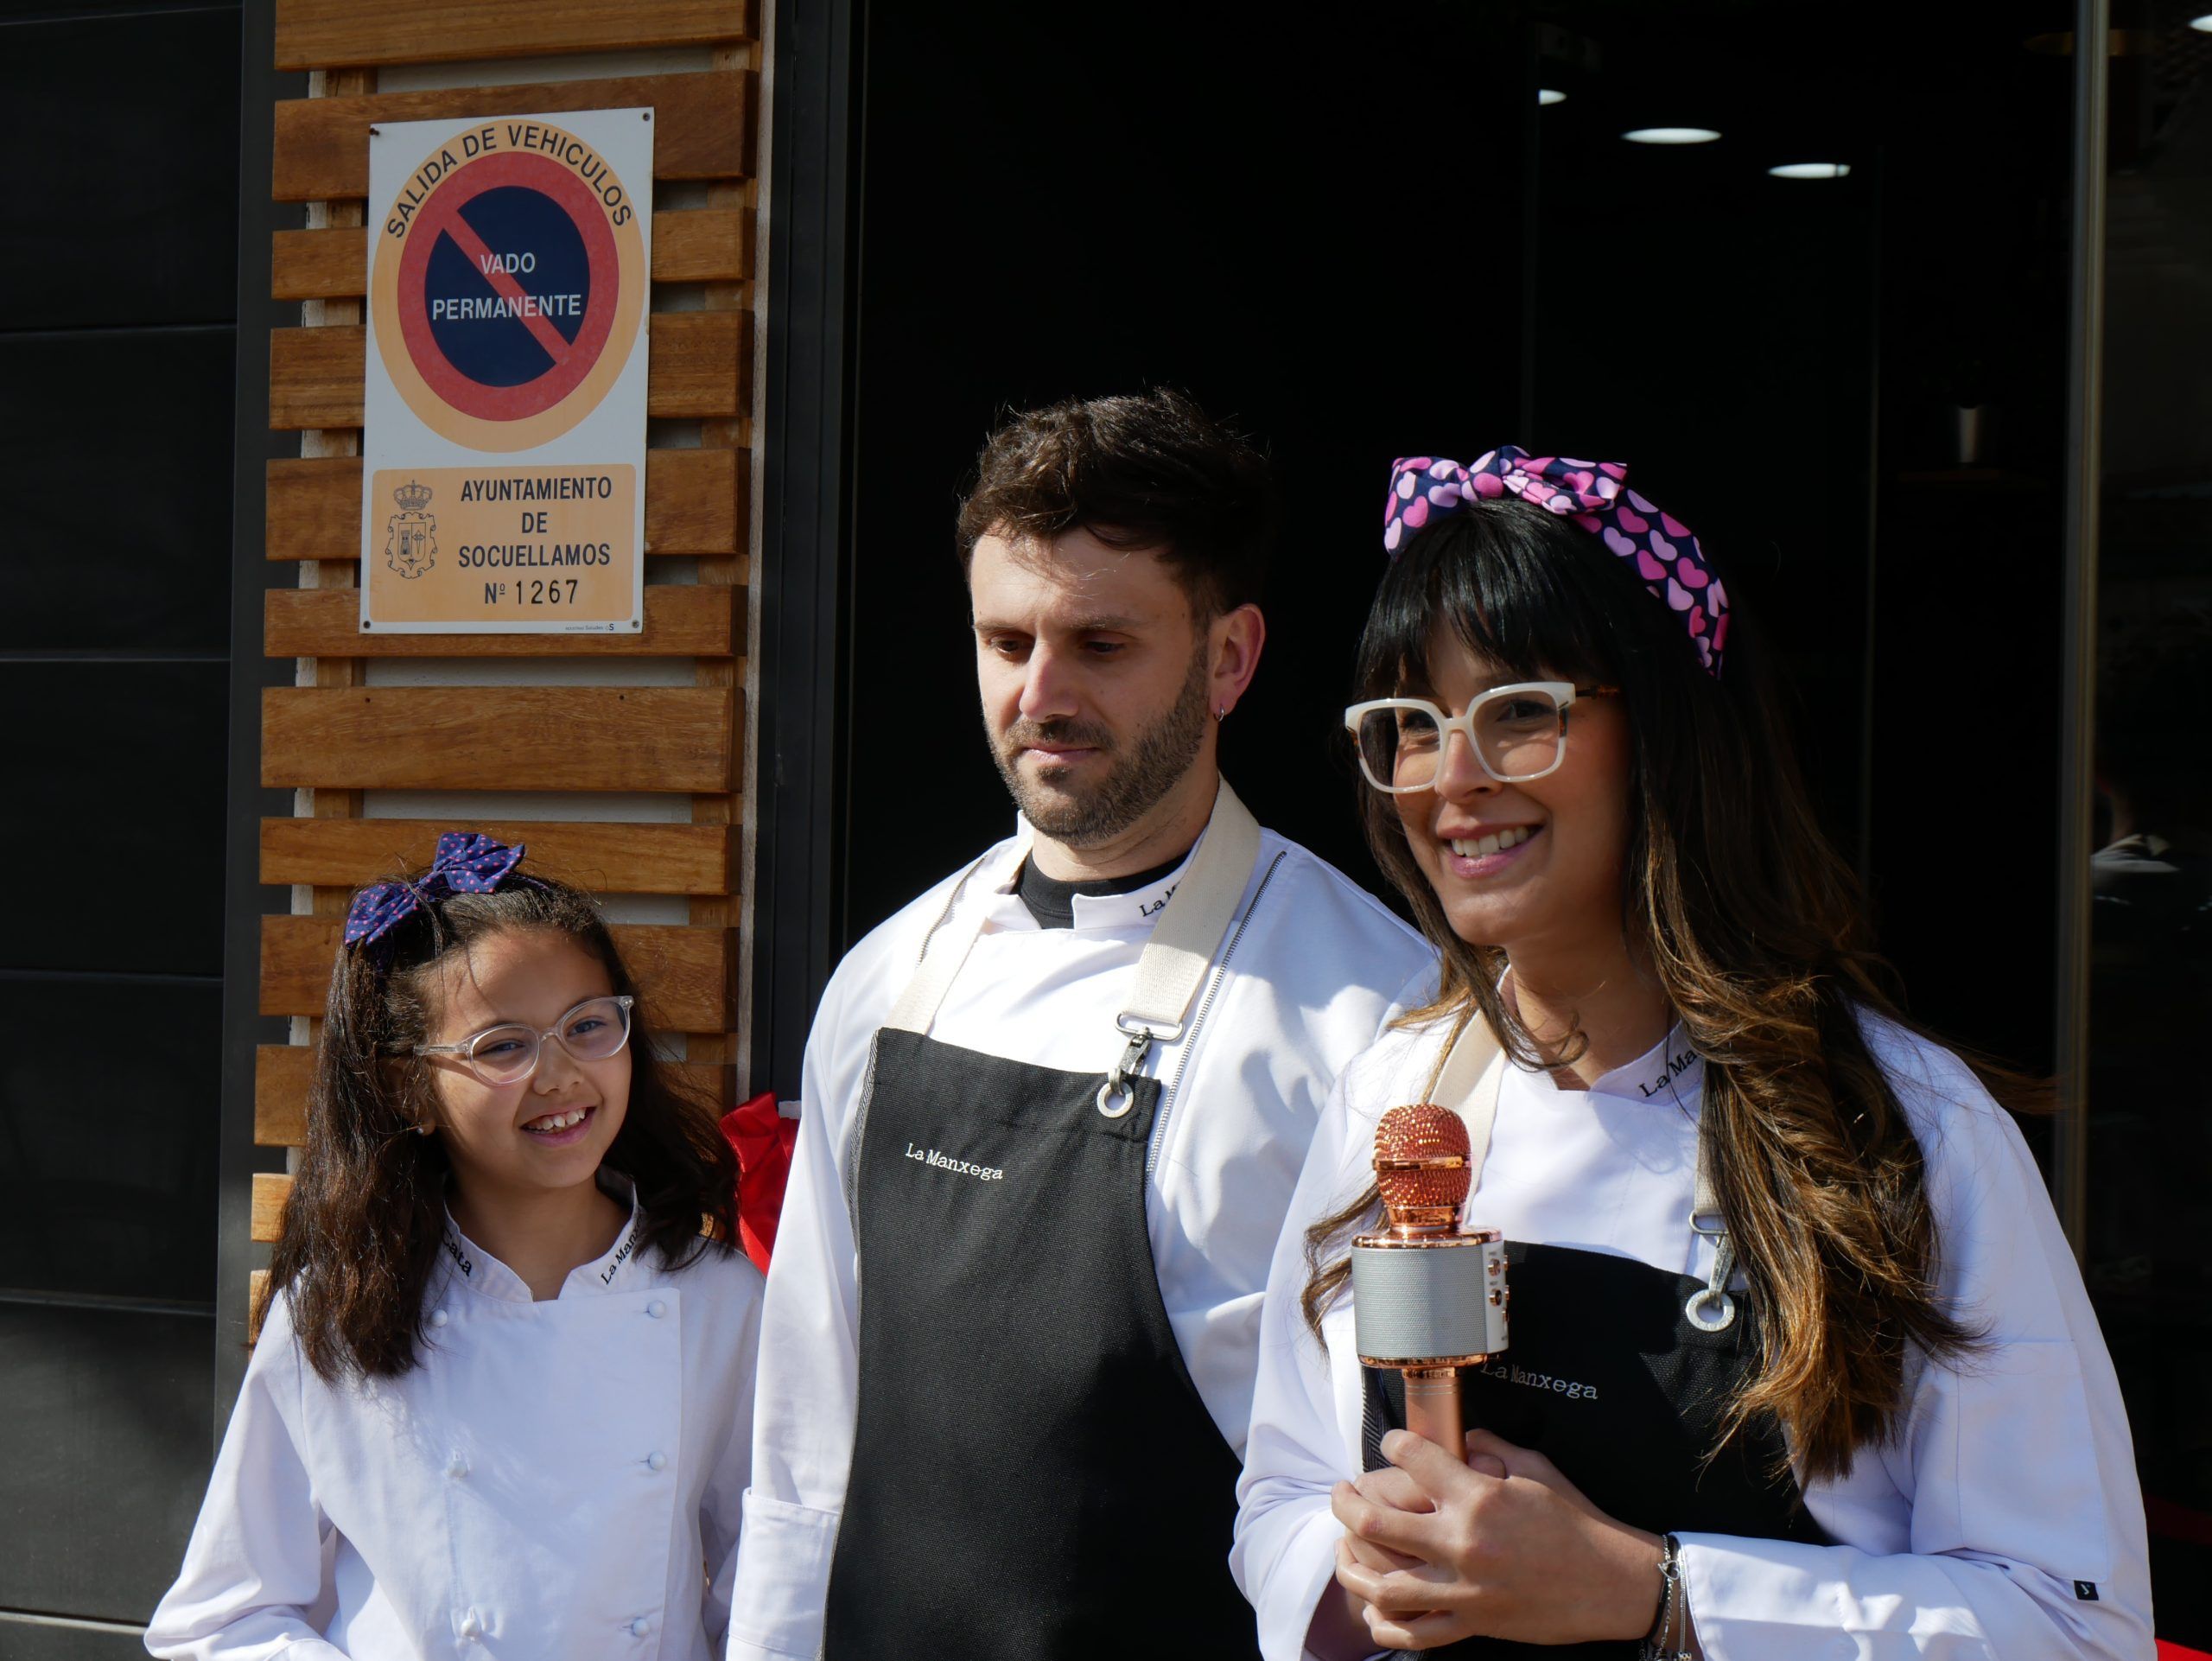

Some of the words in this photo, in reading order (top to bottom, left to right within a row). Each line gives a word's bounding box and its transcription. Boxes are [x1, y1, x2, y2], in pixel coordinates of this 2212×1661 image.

[388, 150, 458, 239] SALIDA
[462, 128, 497, 158] DE
[507, 124, 632, 226] VEHICULOS
[480, 251, 537, 275] VADO
[432, 294, 582, 321] PERMANENTE
[460, 476, 613, 502] AYUNTAMIENTO
[521, 512, 548, 534] DE
[458, 543, 611, 568] SOCUELLAMOS
[516, 579, 579, 605] 1267
[1139, 900, 1166, 917] La
[1638, 1075, 1670, 1097] La
[1669, 1049, 1698, 1078] Ma
[905, 1142, 925, 1161] La
[925, 1149, 1003, 1181] Manxega
[442, 1228, 472, 1277] Cata
[601, 1264, 617, 1285] La
[1479, 1362, 1509, 1380] La
